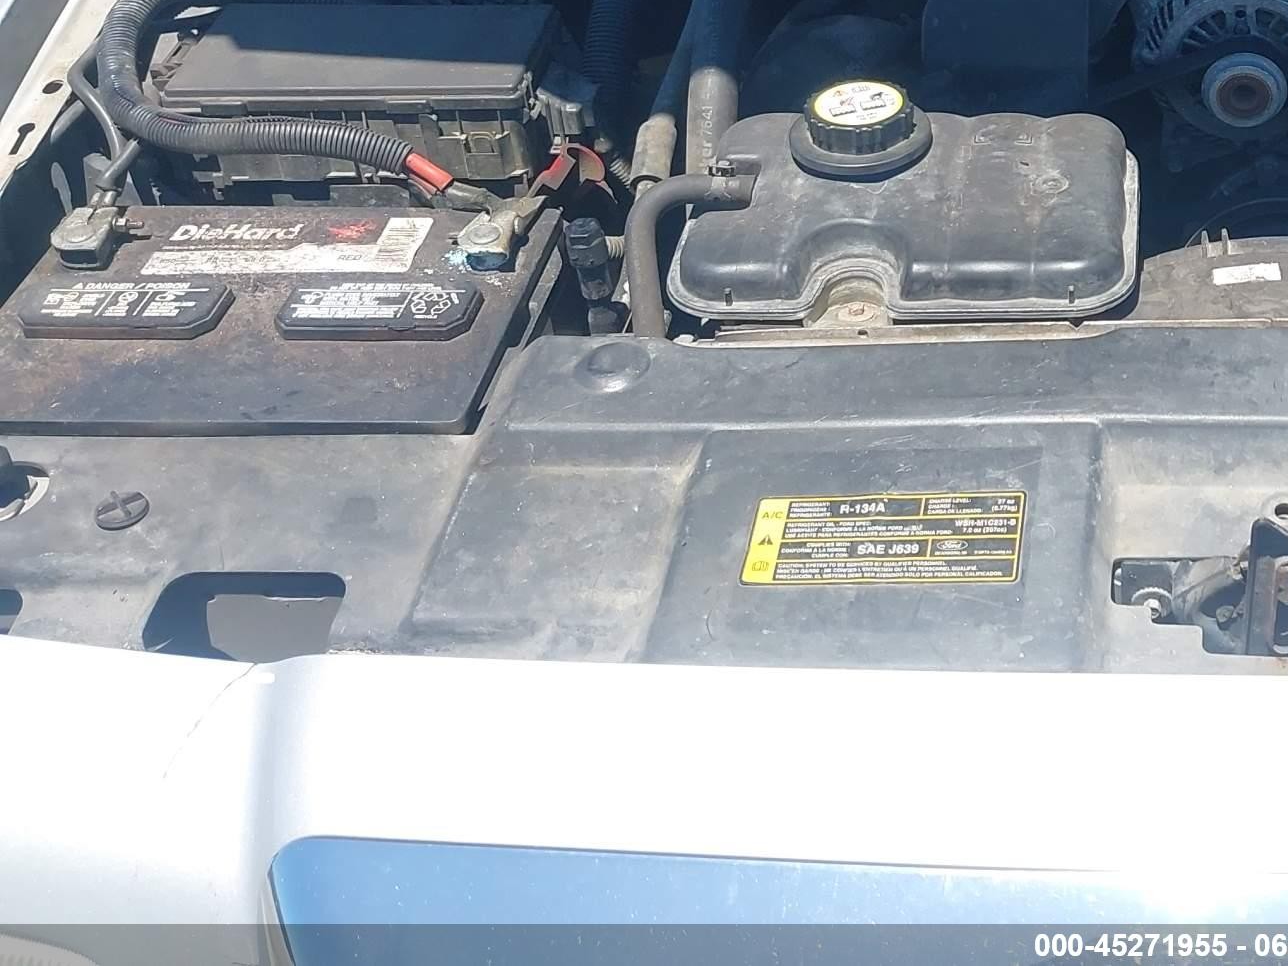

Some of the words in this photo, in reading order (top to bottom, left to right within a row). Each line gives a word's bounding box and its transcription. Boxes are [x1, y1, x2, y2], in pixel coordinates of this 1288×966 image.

[169, 223, 304, 242] DieHard
[839, 502, 886, 514] R-134A
[761, 511, 783, 519] A/C
[857, 543, 885, 555] SAE
[888, 543, 920, 554] J639
[941, 539, 963, 550] Ford
